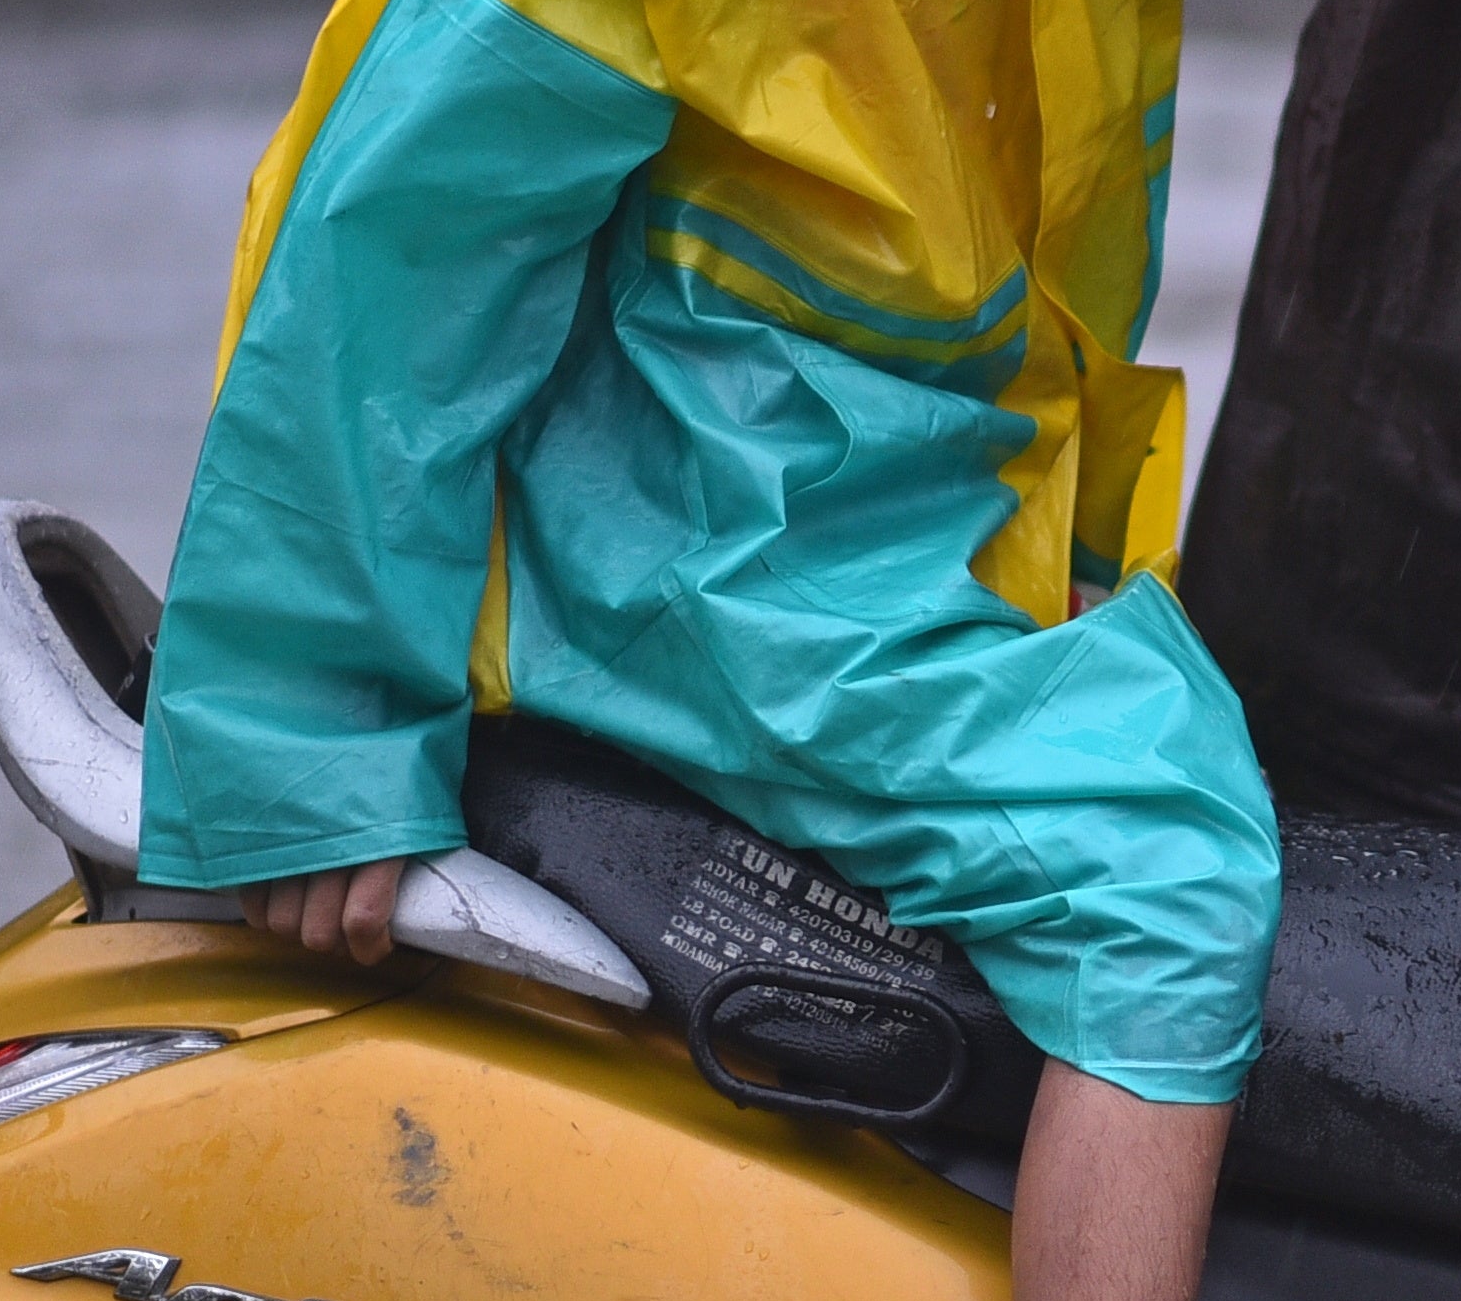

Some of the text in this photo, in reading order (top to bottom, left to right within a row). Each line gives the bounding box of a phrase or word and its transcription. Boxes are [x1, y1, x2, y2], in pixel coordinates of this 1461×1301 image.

[690, 874, 738, 912] ASHOK
[701, 858, 761, 898] ADYAR
[788, 904, 936, 981] 42070319/29/39
[804, 878, 945, 964] HONDA
[670, 915, 718, 947] OMR
